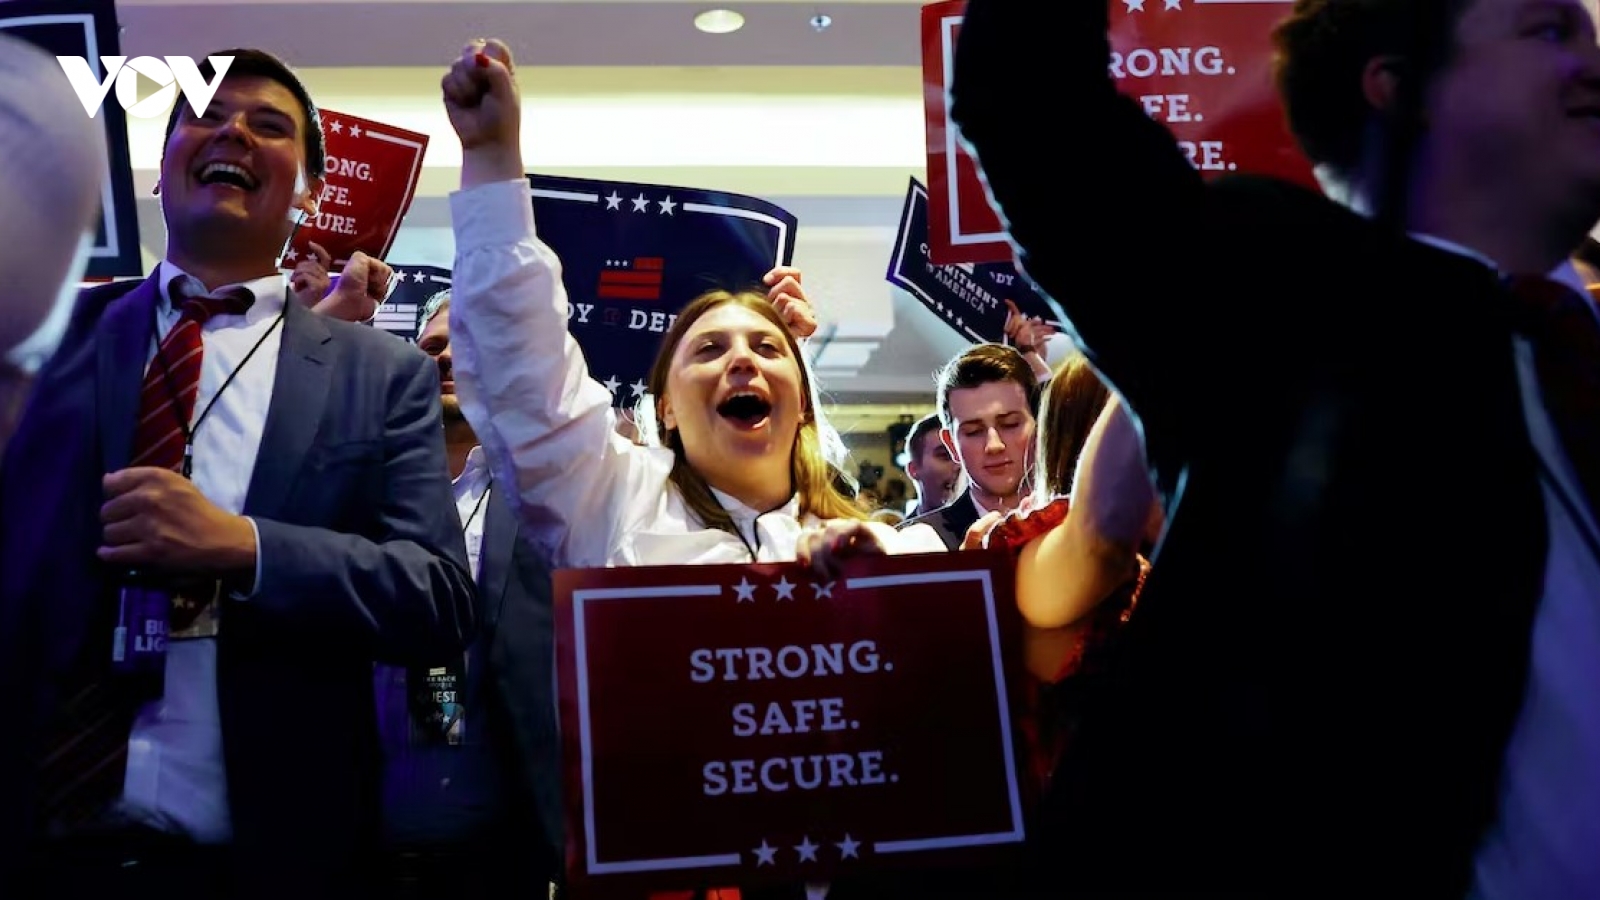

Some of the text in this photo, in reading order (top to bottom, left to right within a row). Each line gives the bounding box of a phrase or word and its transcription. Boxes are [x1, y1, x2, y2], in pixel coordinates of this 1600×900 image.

[1107, 46, 1236, 78] RONG.
[1140, 94, 1203, 122] FE.
[324, 155, 374, 182] ONG.
[322, 183, 352, 206] FE.
[304, 212, 358, 235] URE.
[935, 269, 985, 315] AMERICA
[689, 639, 895, 683] STRONG.
[433, 691, 457, 703] EST
[731, 697, 861, 737] SAFE.
[702, 750, 900, 796] SECURE.
